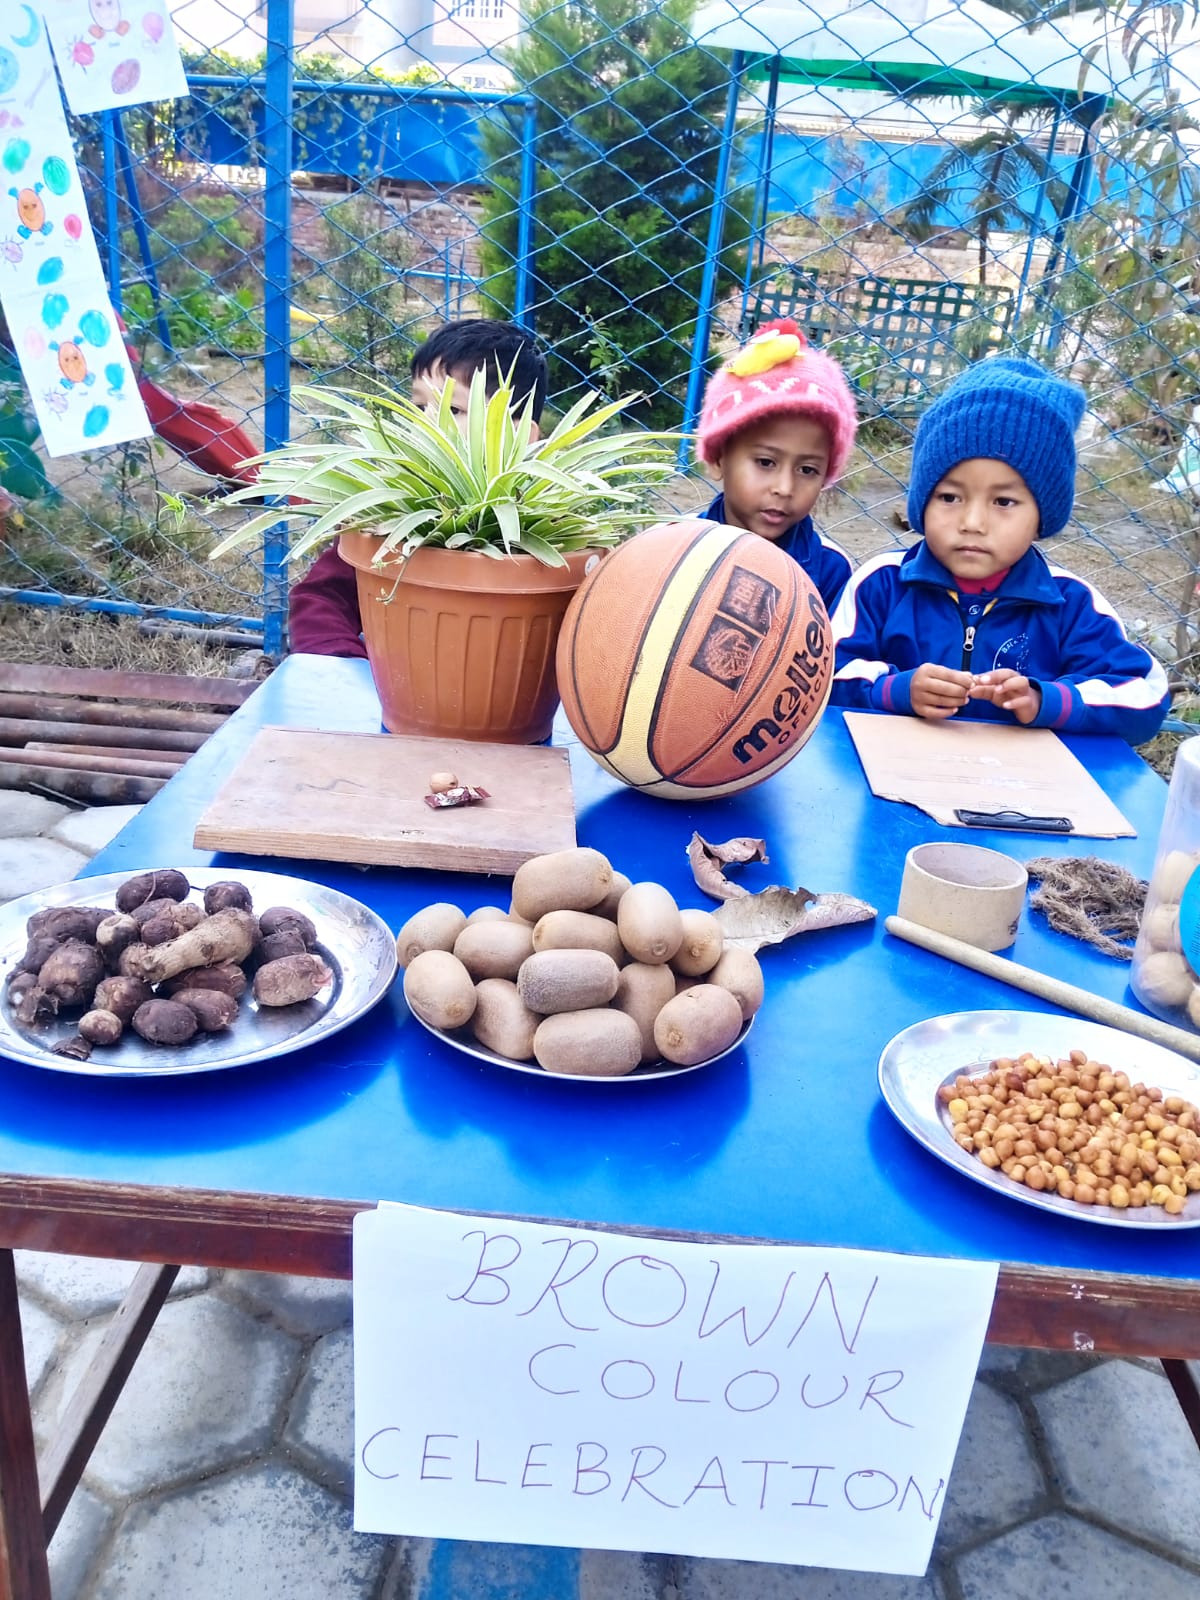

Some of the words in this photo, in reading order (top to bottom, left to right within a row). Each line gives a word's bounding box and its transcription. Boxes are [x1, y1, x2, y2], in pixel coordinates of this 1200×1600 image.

[732, 592, 826, 764] molten
[778, 643, 831, 744] OFFICIAL
[447, 1230, 879, 1354] BROWN
[528, 1343, 915, 1428] COLOUR
[361, 1427, 945, 1521] CELEBRATION
